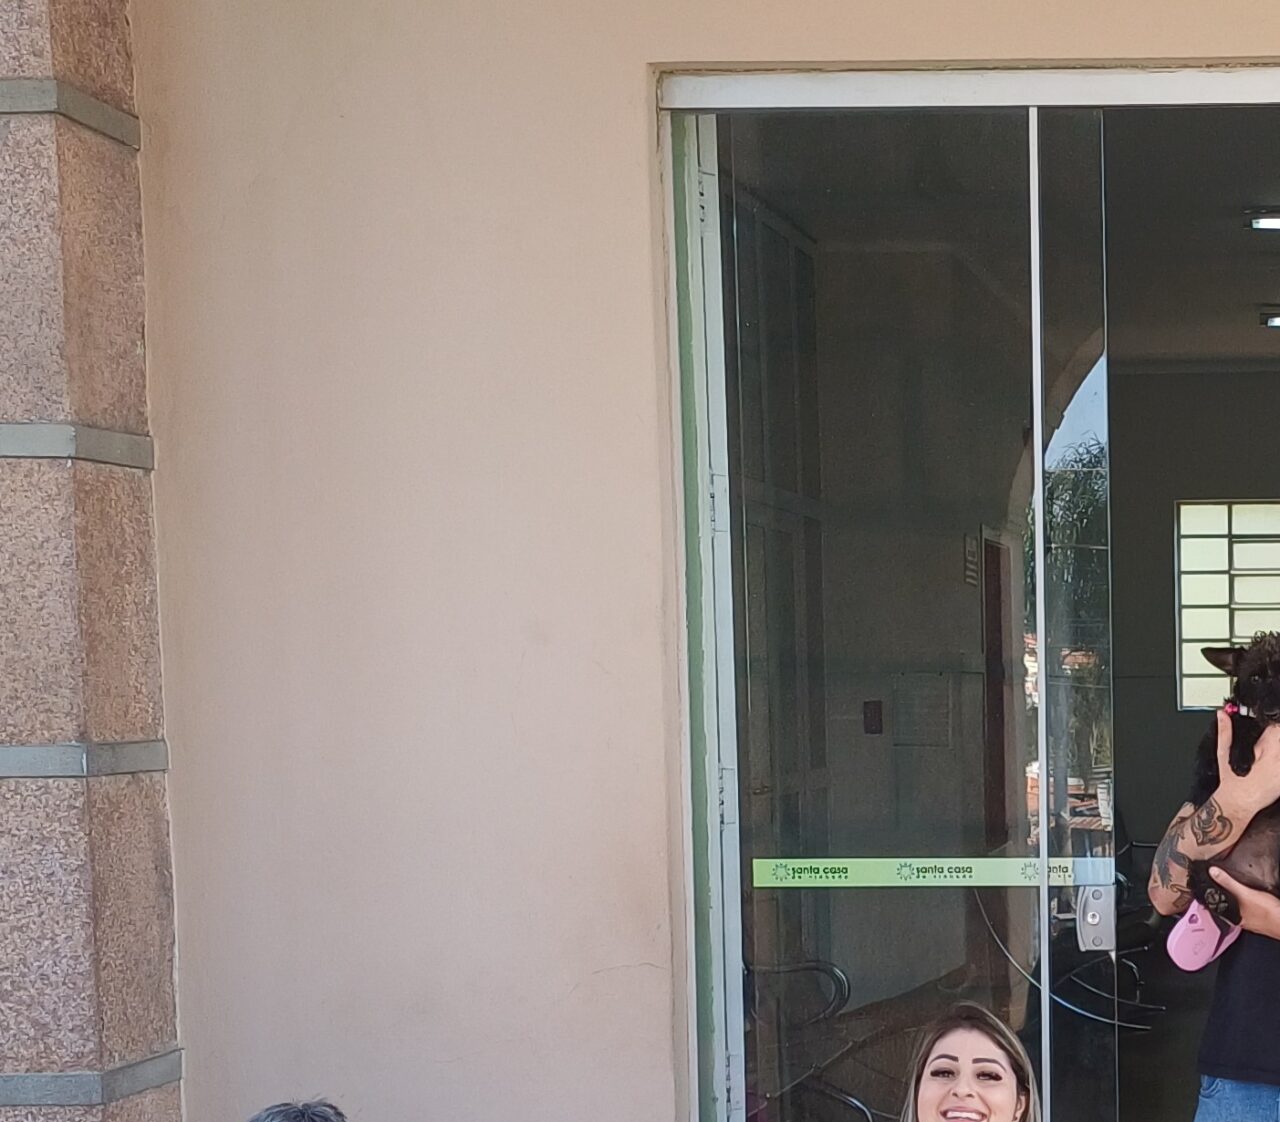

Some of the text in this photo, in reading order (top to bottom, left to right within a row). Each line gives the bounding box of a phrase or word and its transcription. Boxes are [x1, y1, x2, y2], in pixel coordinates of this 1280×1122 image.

[792, 865, 848, 874] santa casa
[916, 865, 973, 874] santa casa
